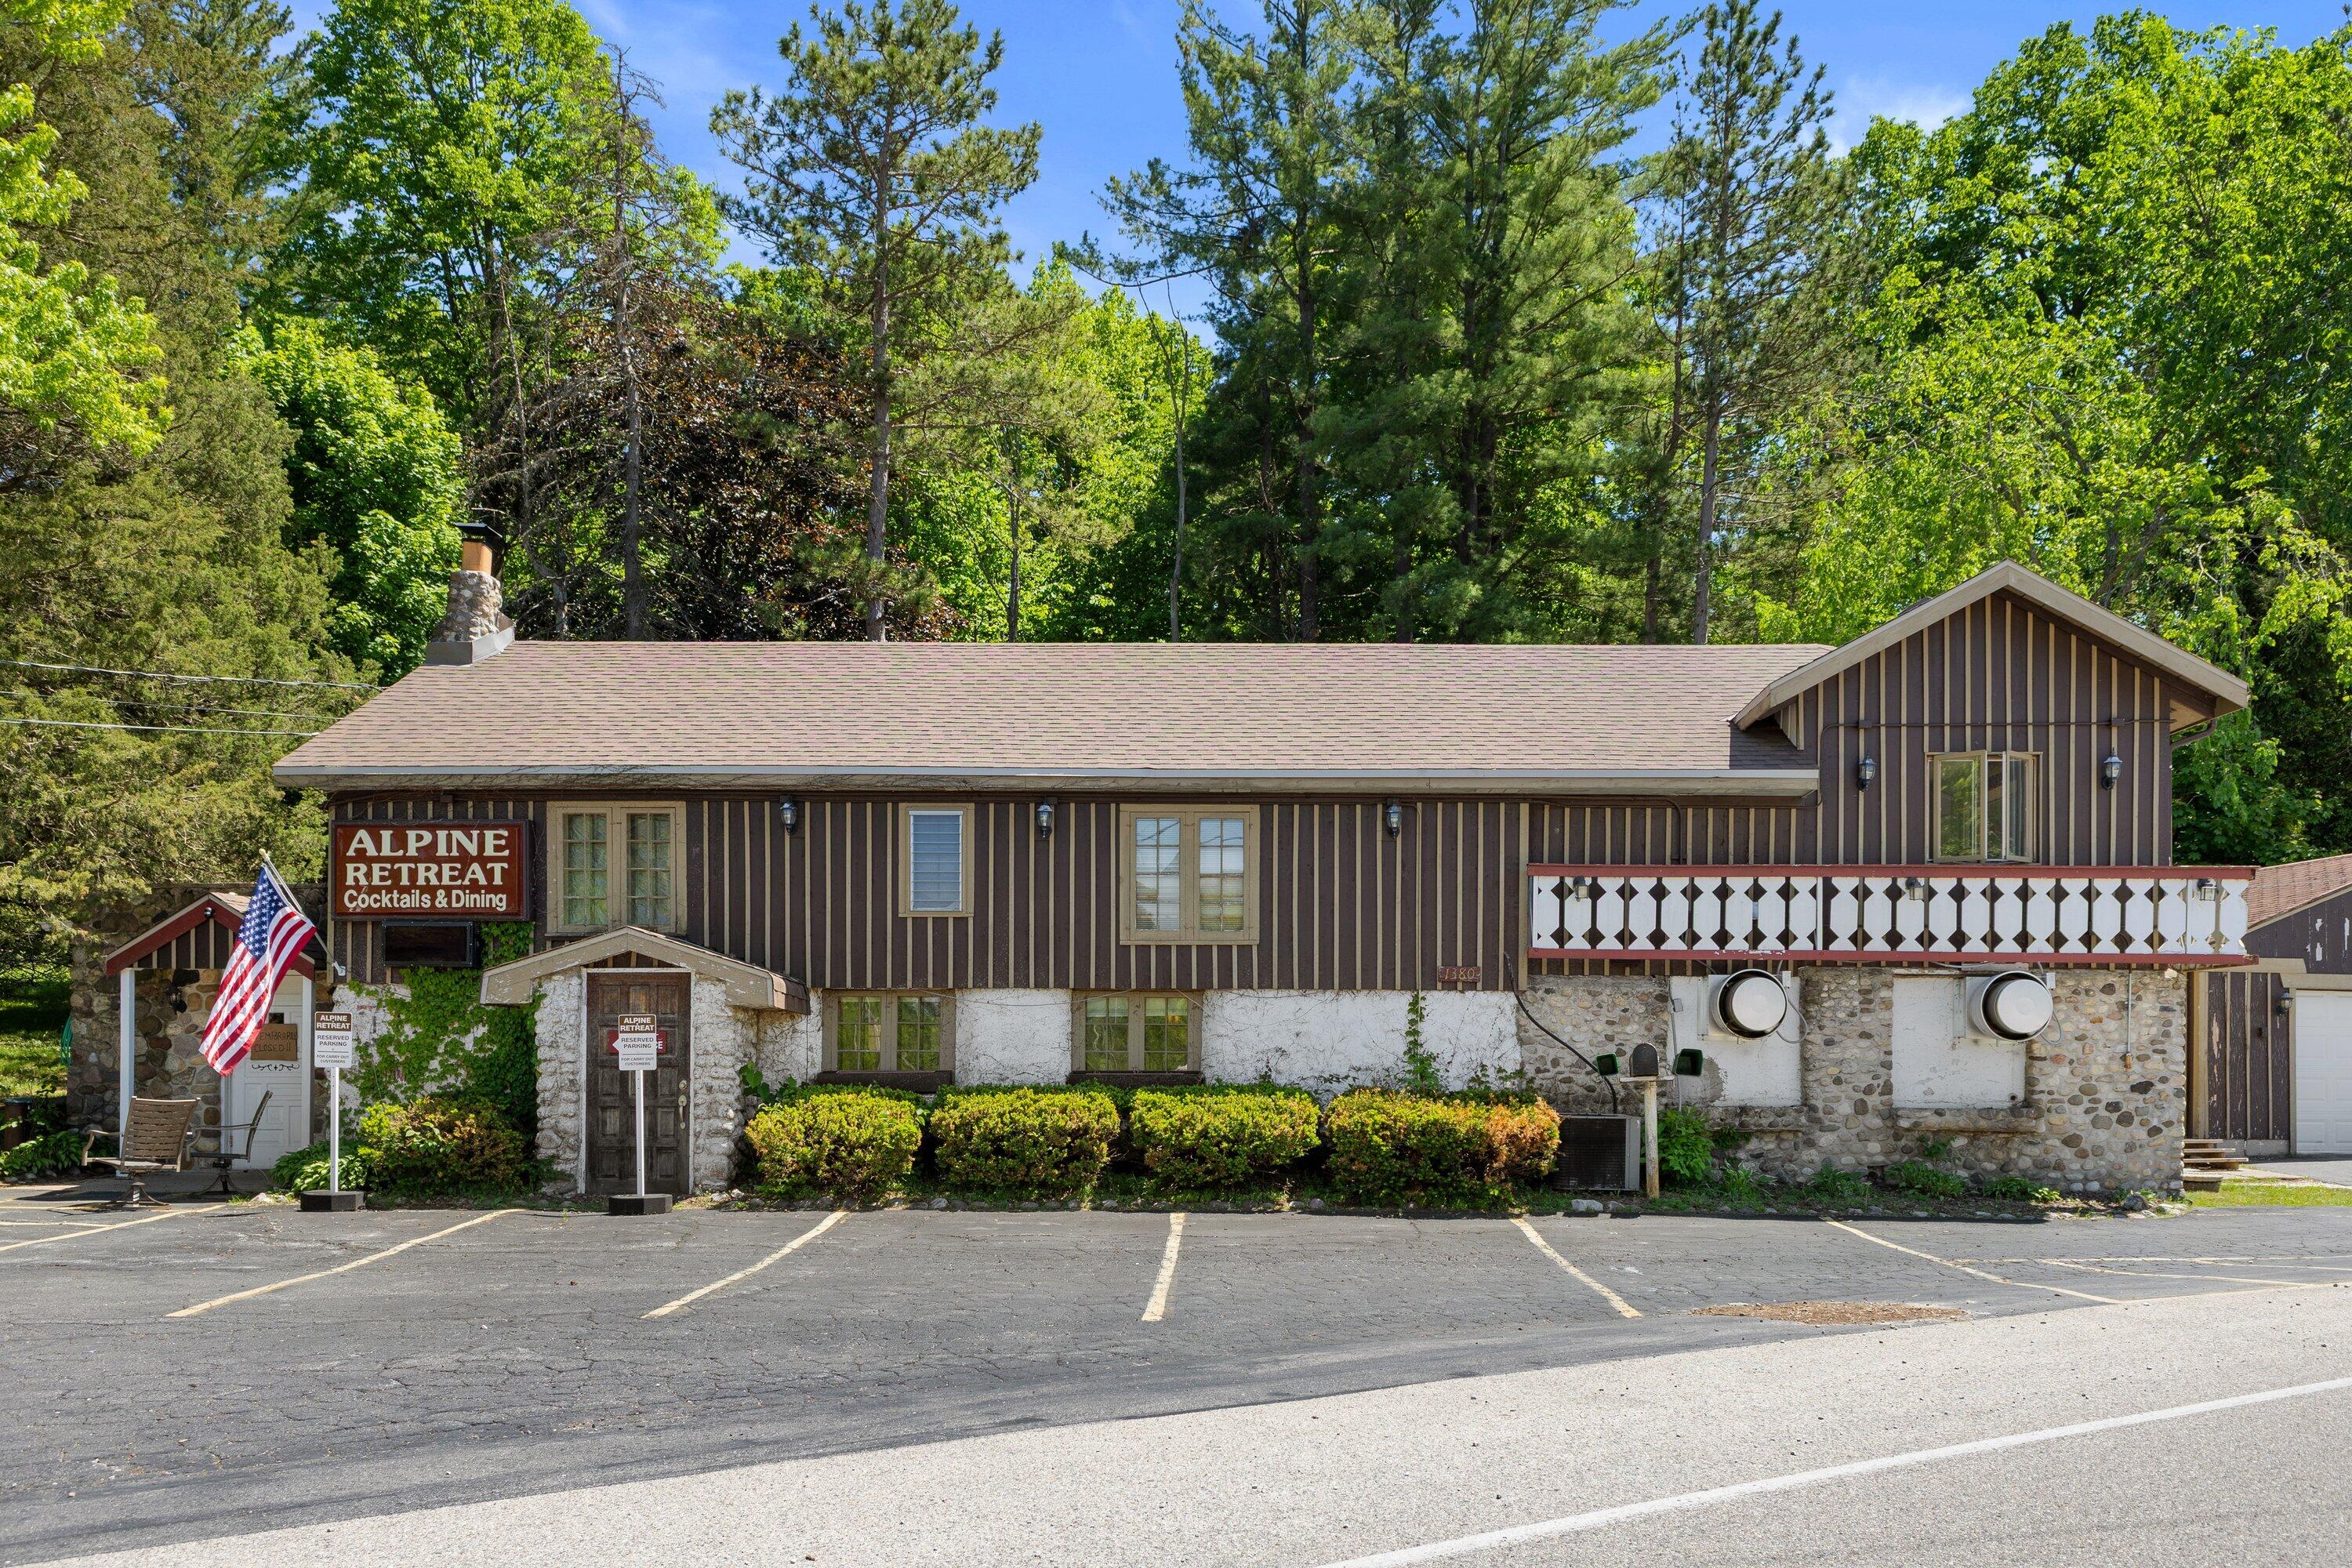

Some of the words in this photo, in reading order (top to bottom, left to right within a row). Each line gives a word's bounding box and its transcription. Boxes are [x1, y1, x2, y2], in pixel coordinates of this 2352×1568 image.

[346, 829, 510, 857] ALPINE
[345, 862, 509, 886] RETREAT
[343, 889, 431, 909] Cocktails
[434, 889, 448, 908] &
[452, 889, 507, 912] Dining
[1444, 967, 1475, 980] 1380
